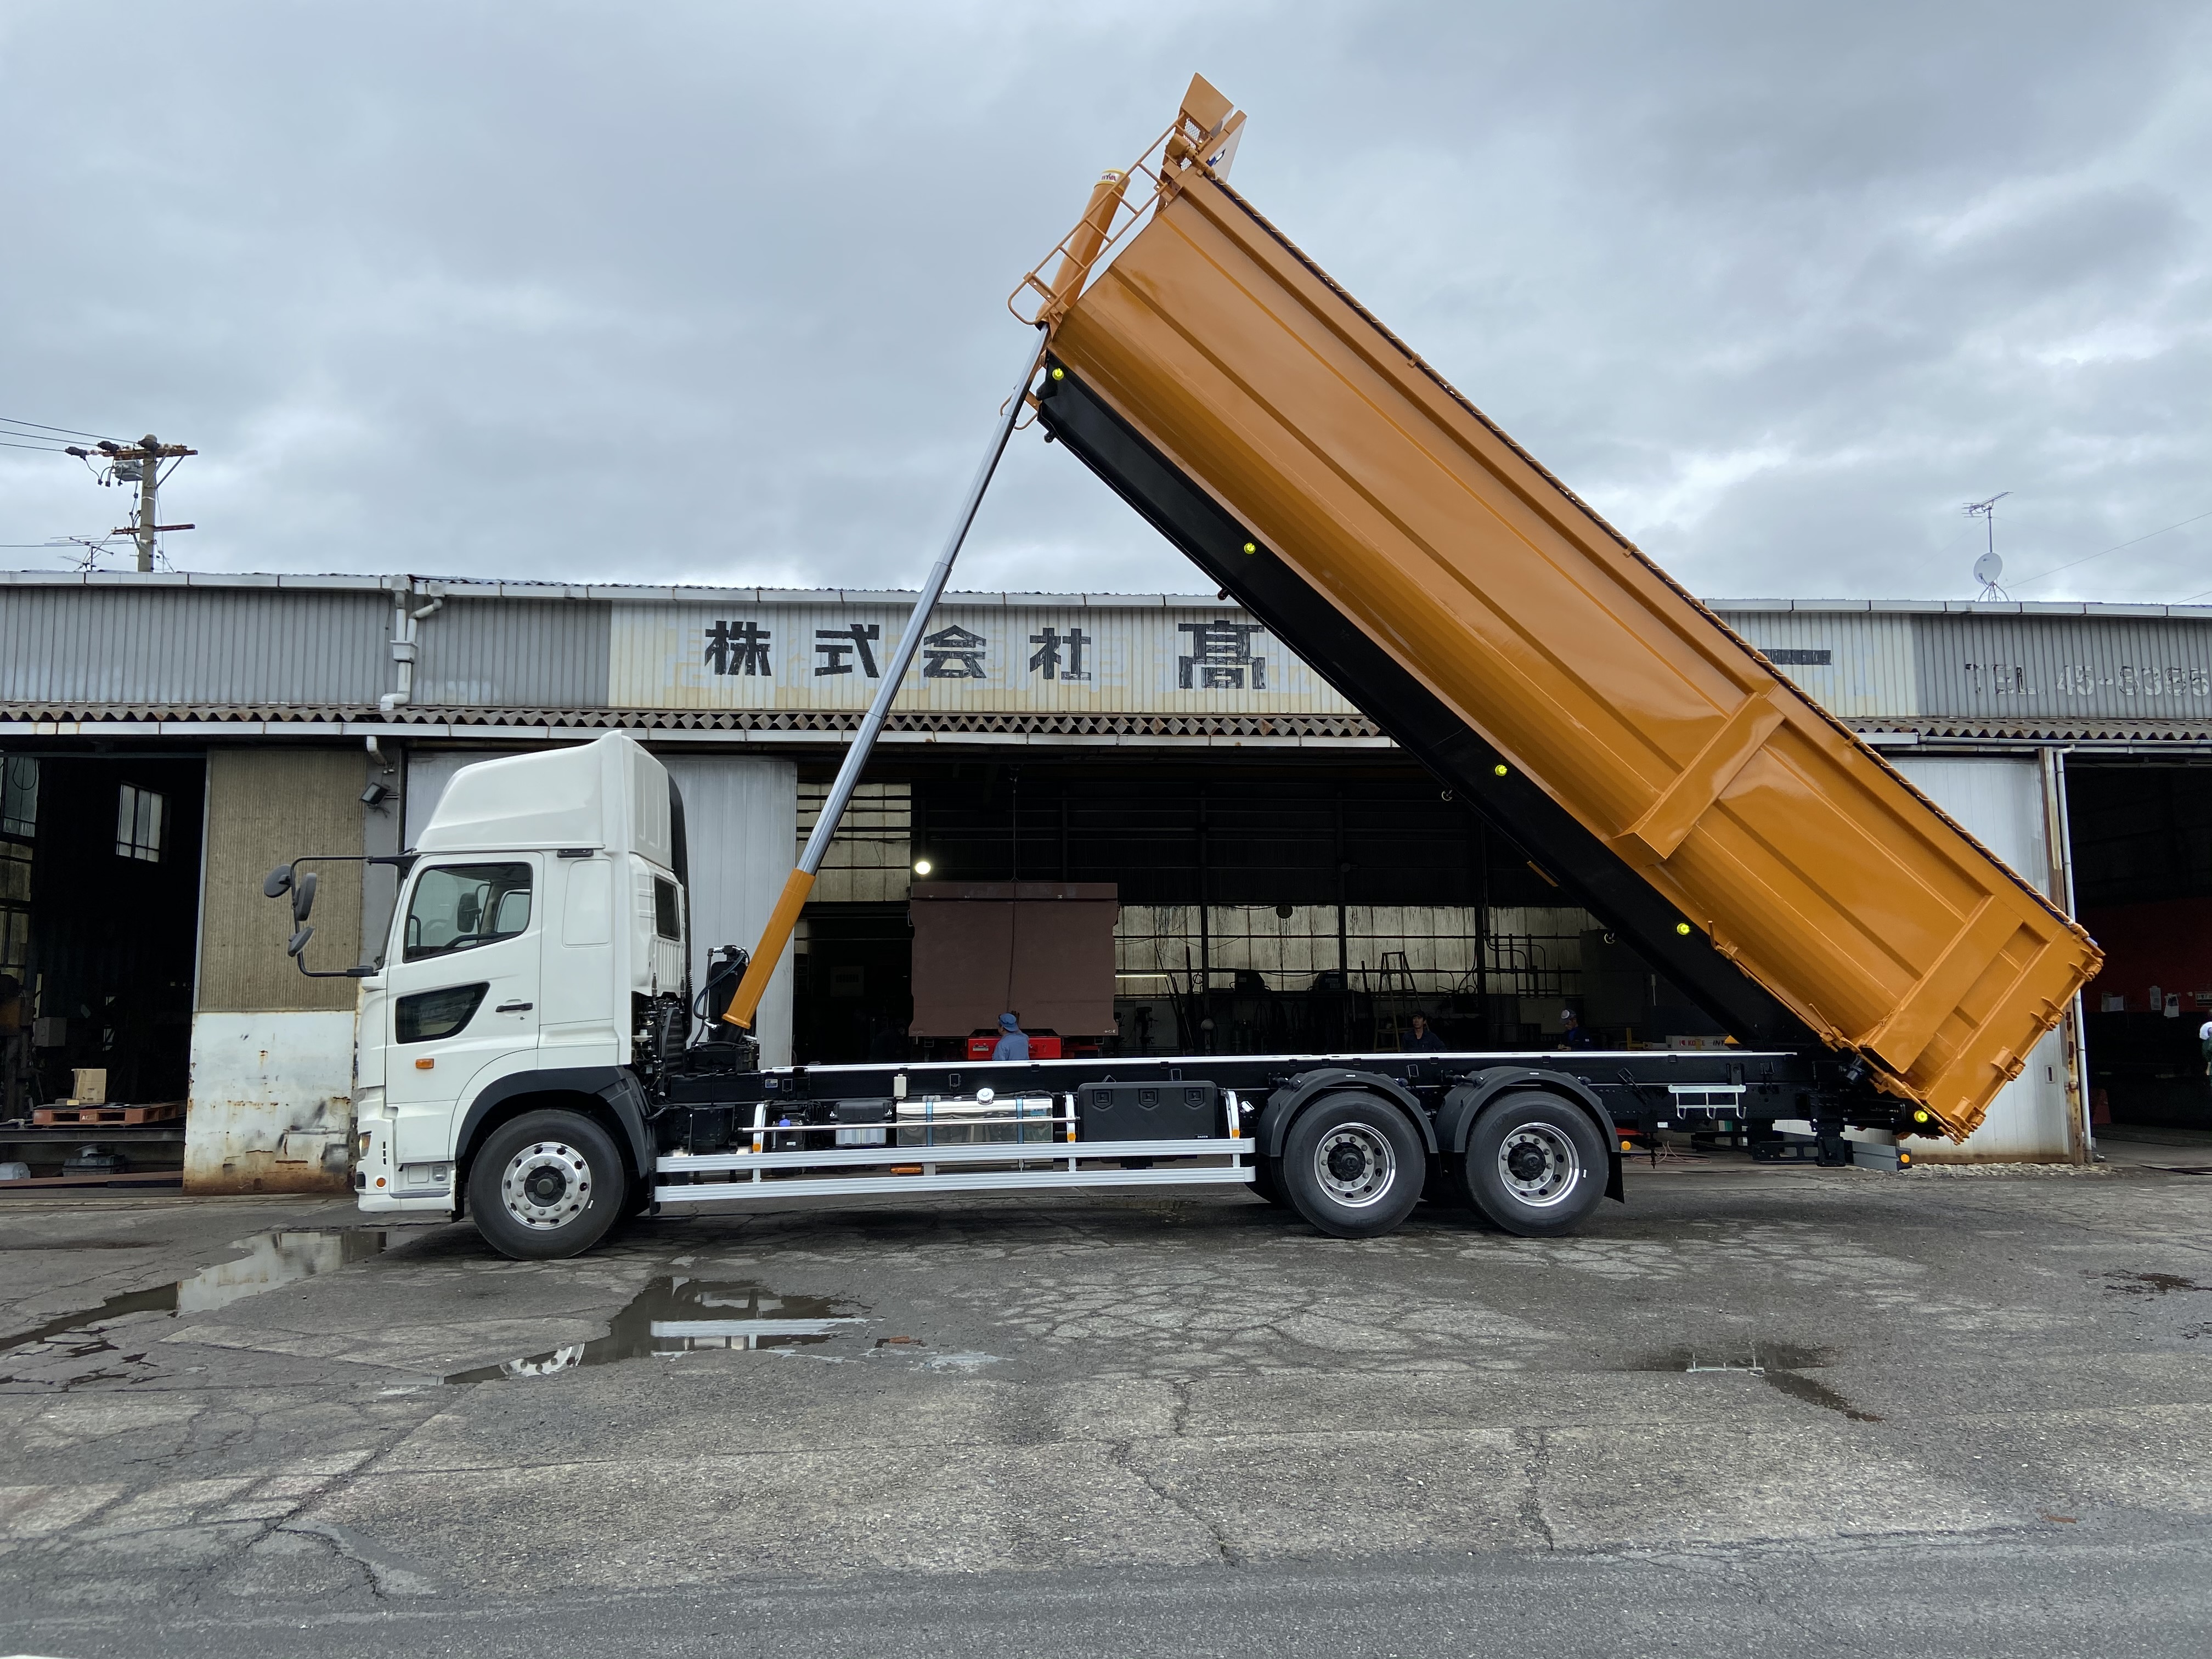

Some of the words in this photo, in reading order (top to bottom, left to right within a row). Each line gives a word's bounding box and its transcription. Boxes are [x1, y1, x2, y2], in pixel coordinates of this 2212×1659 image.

[1101, 173, 1116, 181] HYVA
[704, 620, 1092, 681] 株式会社
